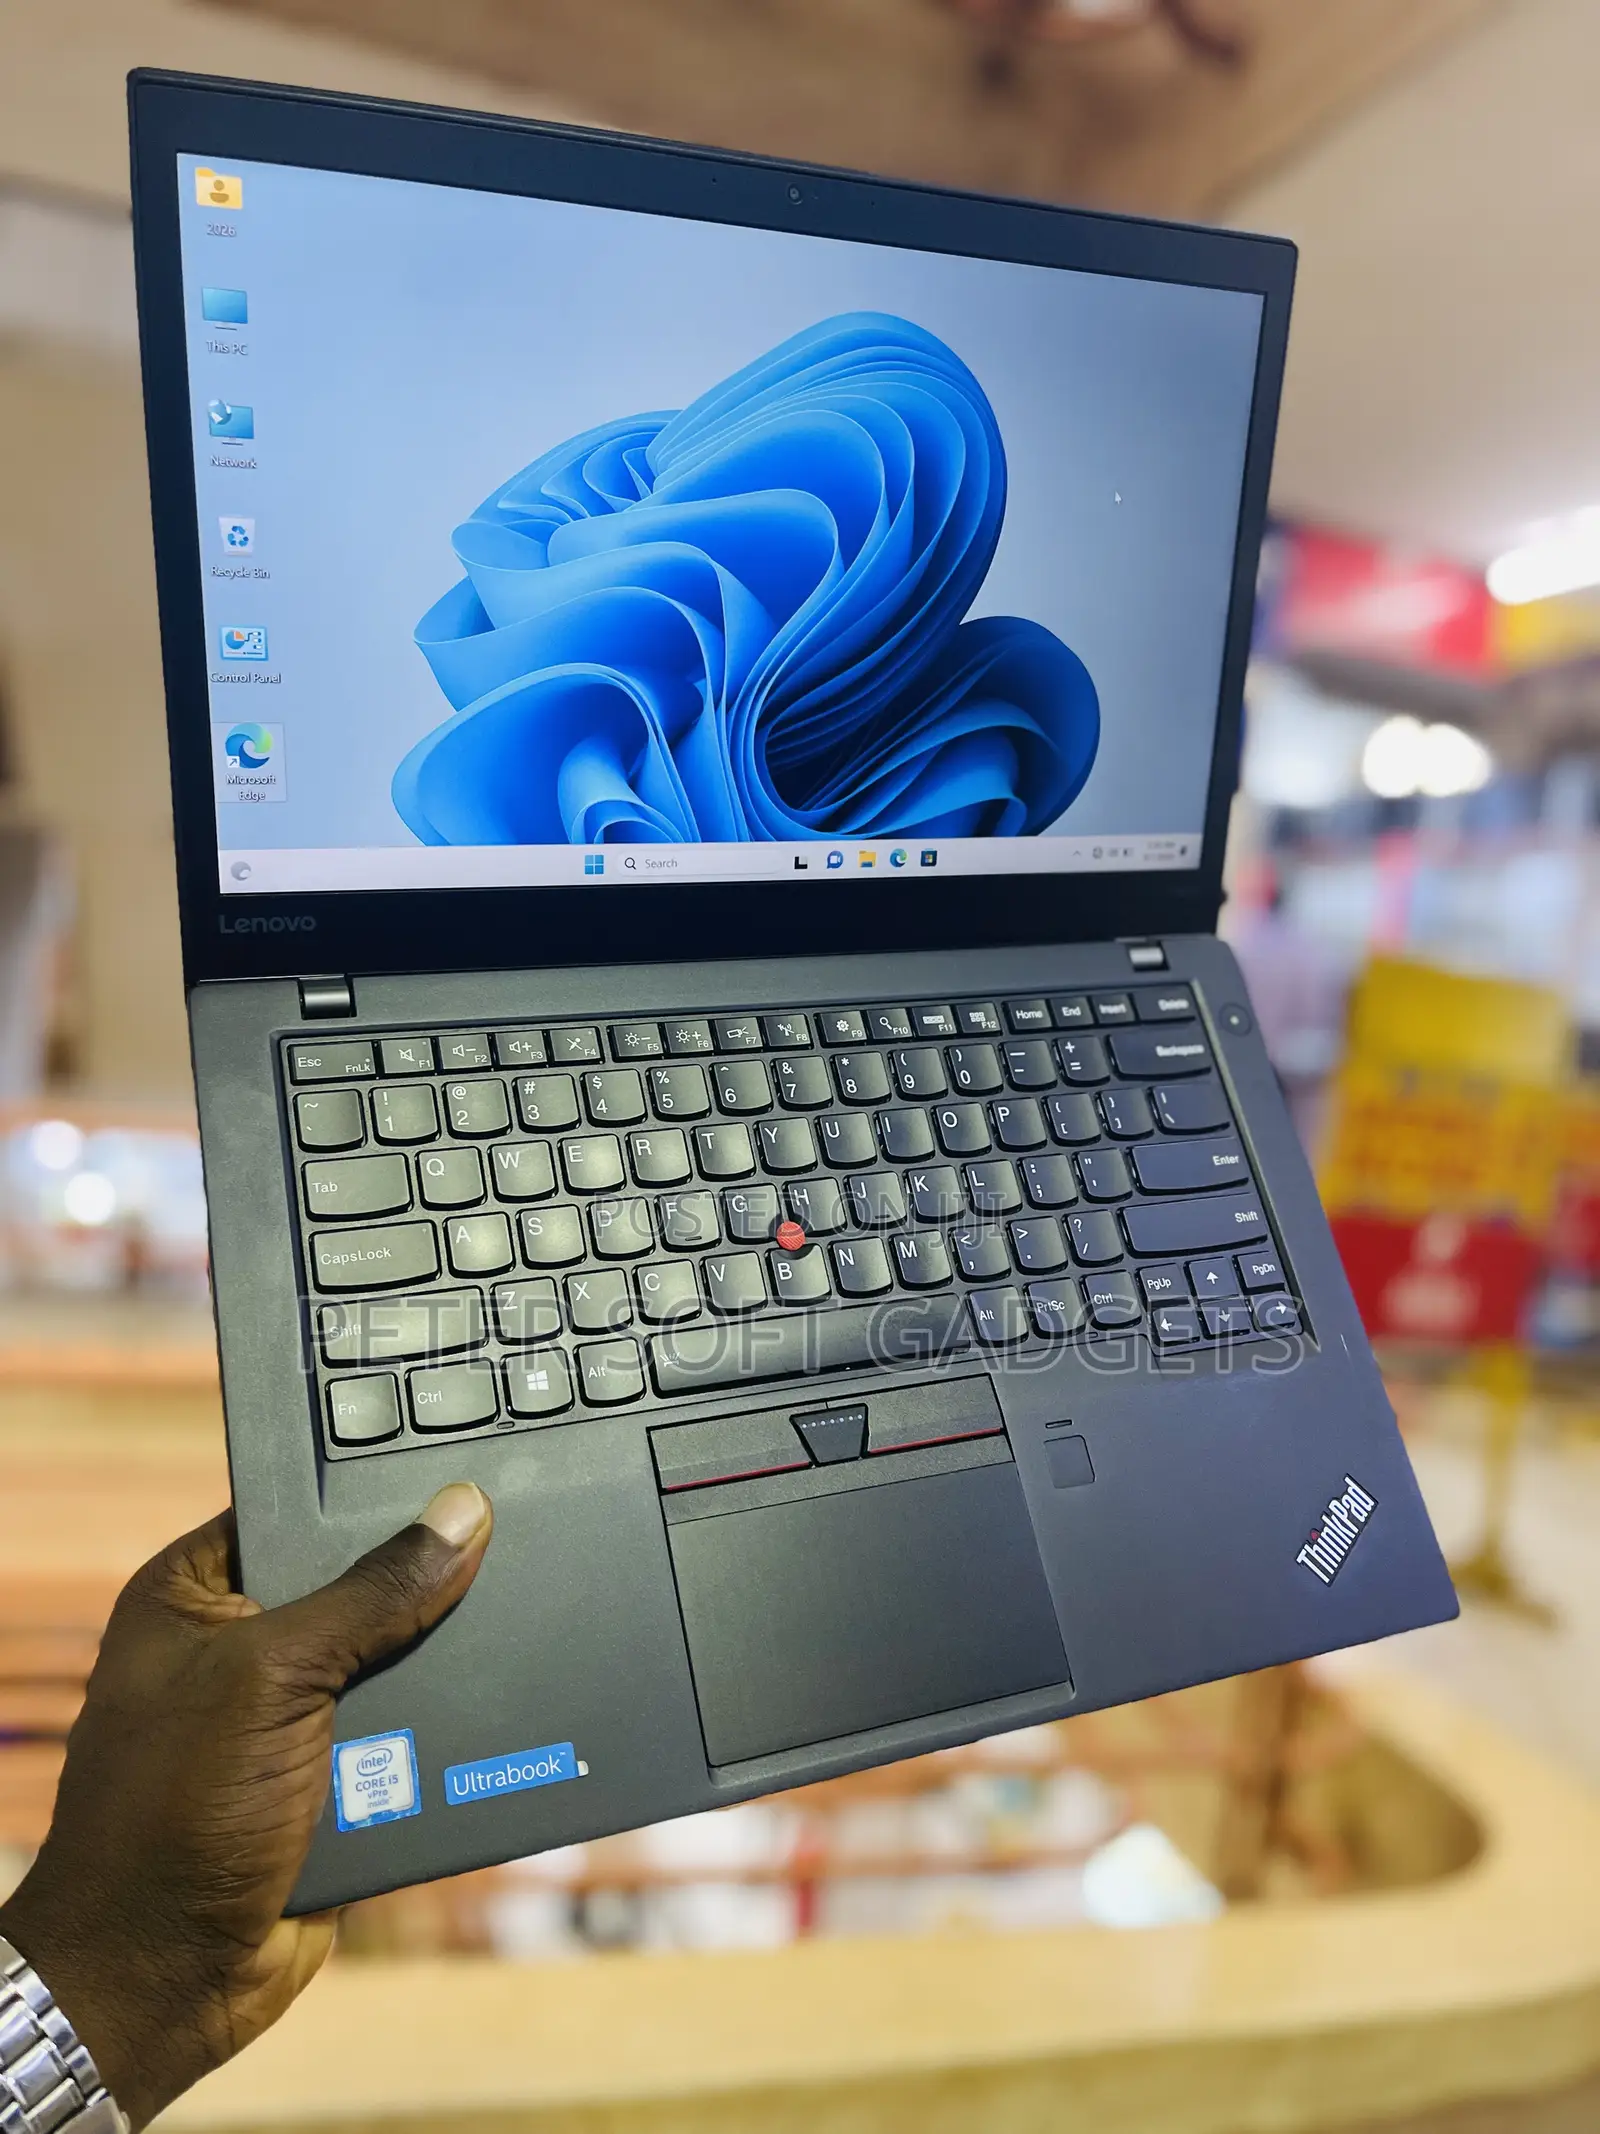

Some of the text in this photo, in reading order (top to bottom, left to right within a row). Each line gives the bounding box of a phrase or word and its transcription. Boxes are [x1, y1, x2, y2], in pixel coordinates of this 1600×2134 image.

[206, 223, 236, 237] 2026
[206, 340, 248, 356] This PC
[210, 455, 258, 470] Network
[211, 566, 271, 580] Recycle Bin
[210, 672, 282, 685] Control Panel
[226, 774, 277, 786] Microsoft
[238, 790, 266, 802] Edge
[645, 857, 678, 869] Search
[219, 914, 317, 934] Lenovo
[1016, 1009, 1043, 1019] Home
[1062, 1006, 1081, 1017] End
[893, 1026, 909, 1035] F10
[938, 1023, 953, 1032] F11
[981, 1021, 997, 1029] F12
[746, 1035, 757, 1045] F7
[796, 1033, 808, 1042] F8
[852, 1029, 863, 1038] F9
[647, 1043, 660, 1052] F5
[697, 1039, 709, 1048] F6
[474, 1054, 488, 1064] F2
[531, 1050, 544, 1060] F3
[584, 1047, 597, 1056] F4
[298, 1056, 322, 1068] Esc
[345, 1064, 371, 1073] FnLk
[419, 1059, 432, 1068] F1
[782, 1062, 794, 1074] &
[592, 1076, 603, 1091] $
[656, 1071, 670, 1084] %
[904, 1074, 915, 1089] 9
[960, 1070, 971, 1084] 0
[452, 1086, 467, 1100] @
[524, 1081, 536, 1095] #
[786, 1083, 797, 1097] 7
[846, 1079, 857, 1094] 8
[662, 1094, 673, 1109] 5
[725, 1088, 736, 1103] 6
[528, 1105, 540, 1120] 3
[596, 1099, 608, 1114] 4
[457, 1111, 469, 1126] 2
[942, 1112, 958, 1128] O
[997, 1107, 1010, 1123] P
[384, 1117, 394, 1132] 1
[826, 1121, 840, 1139] U
[701, 1133, 715, 1150] T
[764, 1127, 779, 1144] Y
[568, 1145, 584, 1163] E
[635, 1139, 652, 1157] R
[498, 1152, 520, 1170] W
[1212, 1154, 1239, 1165] Enter
[426, 1158, 445, 1177] Q
[913, 1176, 929, 1192] K
[971, 1170, 985, 1187] L
[312, 1181, 338, 1193] Tab
[857, 1182, 867, 1199] J
[732, 1195, 748, 1213] G
[794, 1189, 810, 1206] H
[598, 1209, 613, 1227] D
[666, 1202, 678, 1220] F
[1234, 1211, 1259, 1223] Shift
[527, 1217, 543, 1236] S
[1074, 1219, 1082, 1233] ?
[455, 1226, 471, 1244] A
[321, 1247, 392, 1266] CapsLock
[900, 1241, 917, 1258] M
[838, 1249, 855, 1266] N
[710, 1264, 725, 1282] V
[777, 1263, 793, 1280] B
[1252, 1263, 1276, 1275] PgDn
[644, 1273, 661, 1291] C
[1147, 1278, 1172, 1291] PgUp
[574, 1281, 591, 1300] X
[502, 1292, 518, 1310] Z
[1036, 1300, 1065, 1314] PrtSc
[1093, 1293, 1113, 1306] Ctrl
[979, 1309, 994, 1321] Alt
[329, 1324, 362, 1339] Shift
[588, 1366, 606, 1379] Alt
[417, 1391, 442, 1405] Ctrl
[338, 1403, 357, 1416] Fn
[1296, 1477, 1375, 1583] ThinkPad
[361, 1753, 387, 1770] intel
[453, 1754, 563, 1796] Ultrabook
[355, 1777, 386, 1792] CORE
[367, 1789, 389, 1800] vPro
